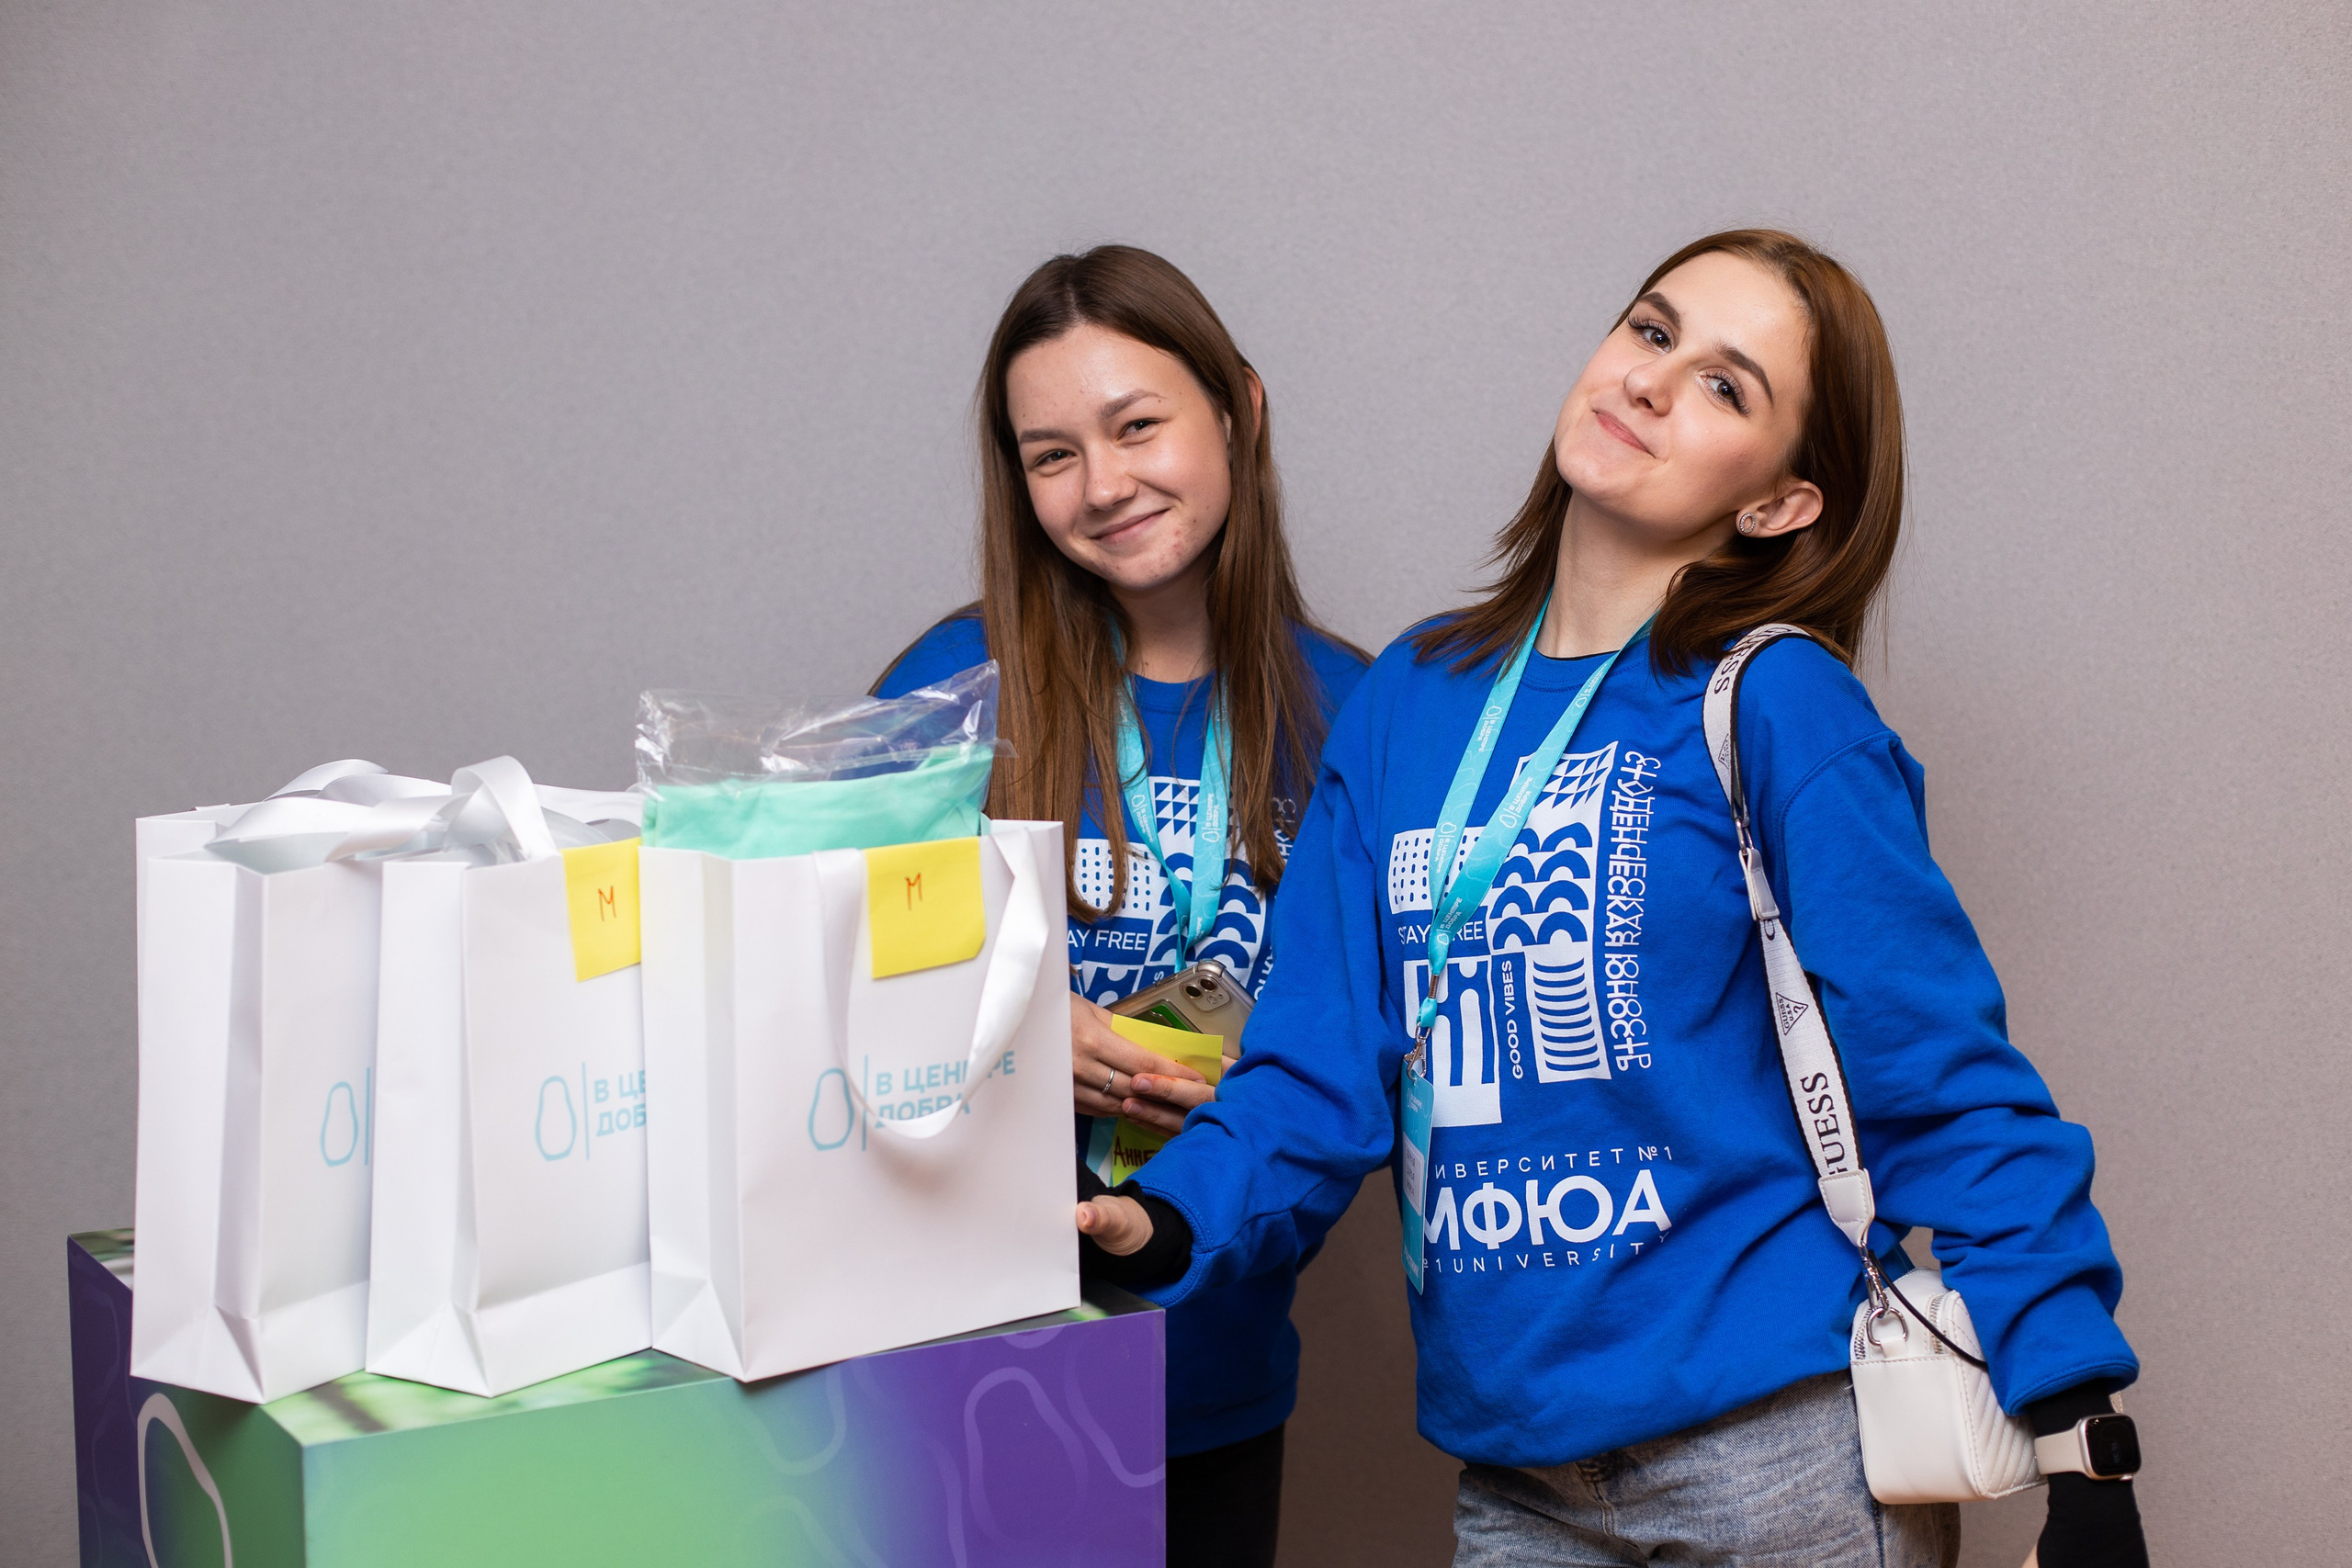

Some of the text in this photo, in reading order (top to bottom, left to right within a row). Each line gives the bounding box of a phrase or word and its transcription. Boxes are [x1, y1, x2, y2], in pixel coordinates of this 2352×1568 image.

[1515, 791, 1532, 814] ДОБРА
[1445, 910, 1463, 931] ДОБРА
[1067, 929, 1148, 952] AY FREE
[1501, 960, 1524, 1079] GOOD VIBES
[876, 1072, 892, 1096] В
[595, 1102, 647, 1137] ДОБ
[1434, 1148, 1623, 1179] ИВЕРСИТЕТ
